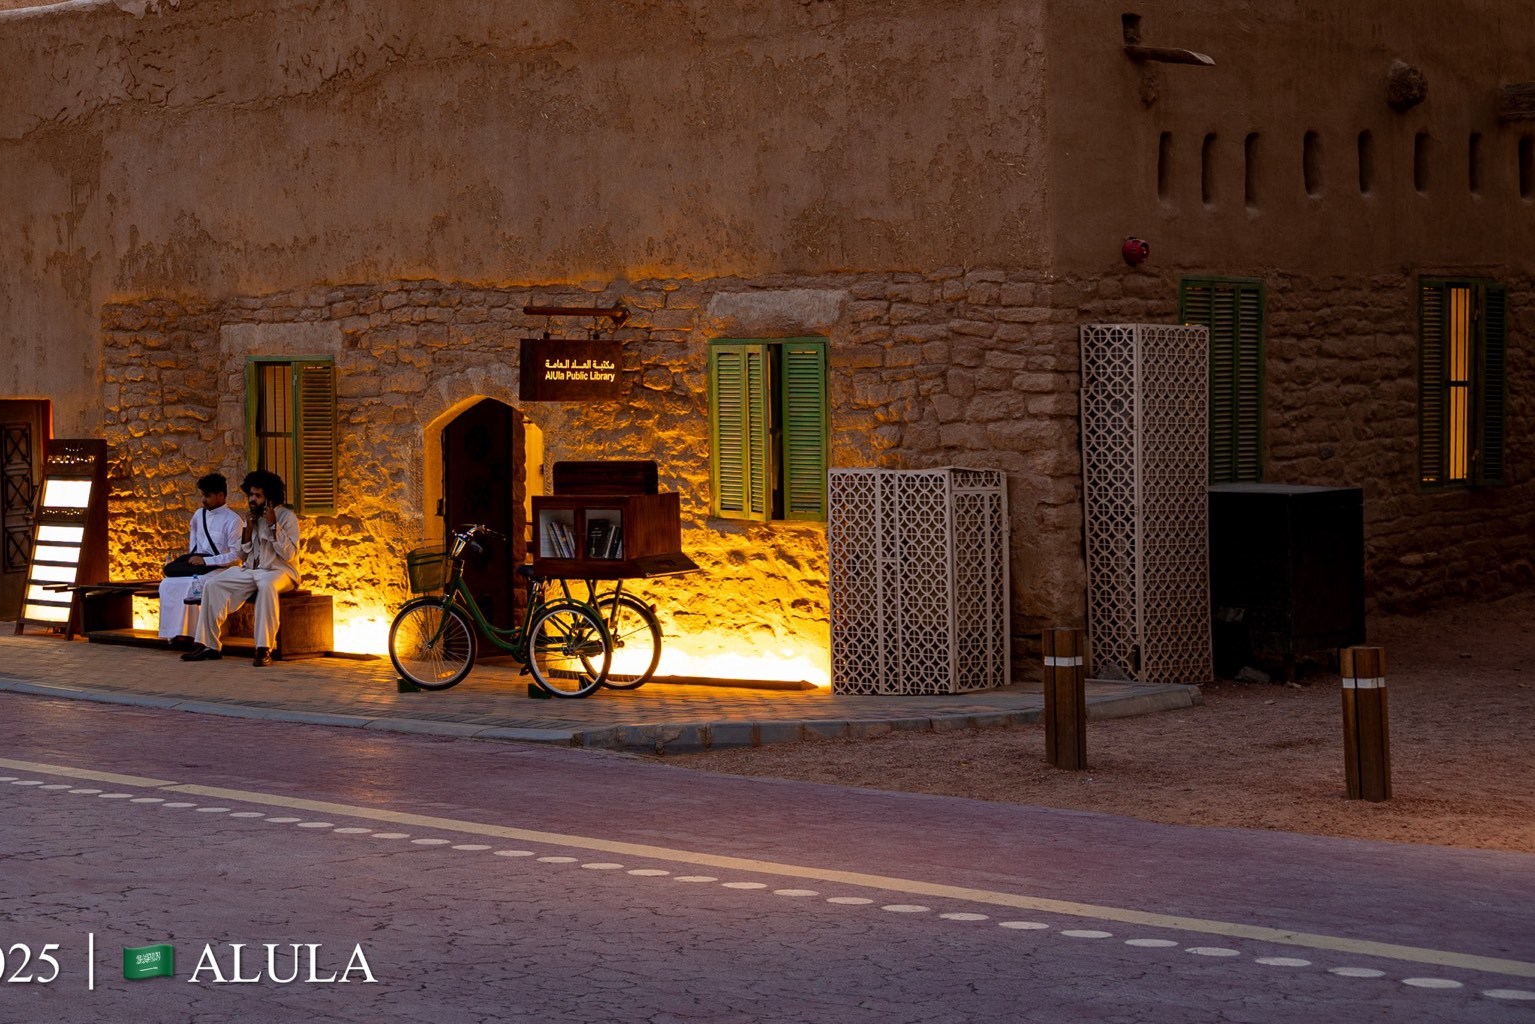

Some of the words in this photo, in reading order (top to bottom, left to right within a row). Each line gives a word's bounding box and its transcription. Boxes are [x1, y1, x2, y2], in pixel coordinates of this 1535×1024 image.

[545, 359, 570, 369] العامة
[592, 360, 615, 371] مكتبة
[545, 371, 565, 381] AlUla
[566, 371, 589, 381] Public
[590, 371, 615, 382] Library
